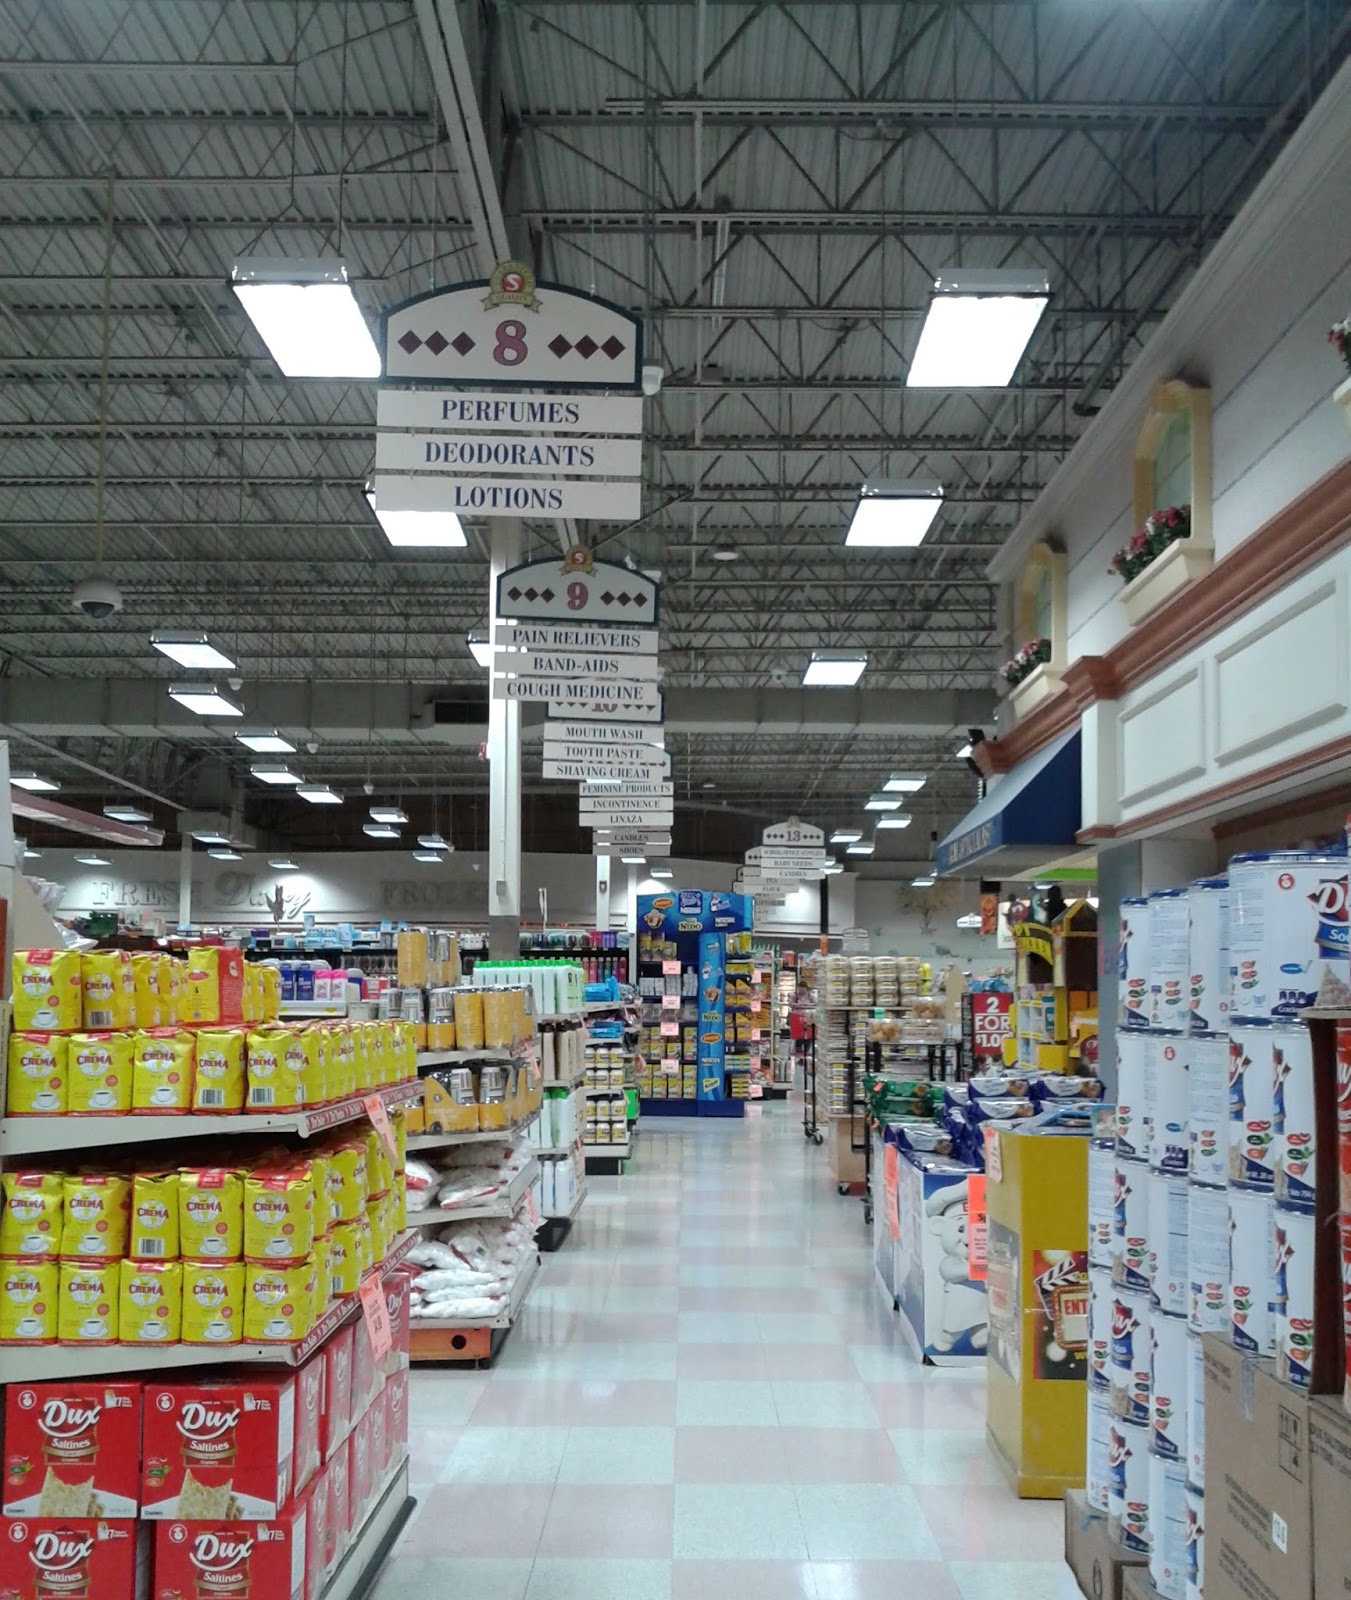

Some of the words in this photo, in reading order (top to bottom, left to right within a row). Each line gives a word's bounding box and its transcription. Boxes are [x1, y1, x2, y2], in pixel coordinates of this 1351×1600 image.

[492, 319, 528, 366] 8
[441, 399, 580, 425] PERFUMES
[425, 441, 595, 467] DEODORANTS
[454, 485, 563, 510] LOTIONS
[566, 581, 589, 611] 9
[512, 629, 548, 644] PAIN
[553, 631, 641, 647] RELIEVERS
[533, 656, 619, 673] BAND-AIDS
[507, 682, 560, 697] COUGH
[566, 684, 643, 700] MEDICINE
[565, 727, 606, 738] MOUTH
[610, 728, 643, 740] WASH
[564, 746, 605, 758] TOOTH
[607, 748, 644, 759] PASTE
[556, 766, 607, 778] SHAVING
[609, 767, 650, 779] CREAM
[582, 785, 624, 794] FEMININE
[626, 784, 671, 793] PRODUCTS
[593, 800, 661, 809] INCONTINENCE
[610, 815, 643, 824] LINAZA
[786, 831, 801, 842] 13
[214, 870, 312, 920] Dary
[21, 974, 54, 986] CREMA
[85, 981, 115, 992] CREMA
[986, 996, 1000, 1013] 2
[974, 1015, 1009, 1031] FOR
[20, 1056, 57, 1069] CREMA
[76, 1055, 113, 1067] CREMA
[142, 1051, 176, 1063] CREMA
[200, 1058, 228, 1069] CREMA
[249, 1058, 278, 1069] CREMA
[8, 1199, 46, 1210] CREMA
[69, 1199, 104, 1210] CREMA
[186, 1202, 222, 1213] CREMA
[253, 1202, 290, 1213] CREMA
[137, 1207, 169, 1219] CREMA
[4, 1281, 41, 1293] CREMA
[68, 1282, 104, 1294] CREMA
[128, 1284, 165, 1297] CREMA
[192, 1285, 229, 1297] CREMA
[253, 1282, 289, 1294] CREMA
[43, 1400, 103, 1428] Dux
[181, 1403, 241, 1430] Dux
[51, 1438, 91, 1450] Saltines
[190, 1440, 230, 1452] Saltines
[34, 1532, 95, 1561] Dux
[195, 1534, 255, 1561] Dux
[42, 1571, 83, 1582] Saltines
[203, 1571, 243, 1584] Saltines
